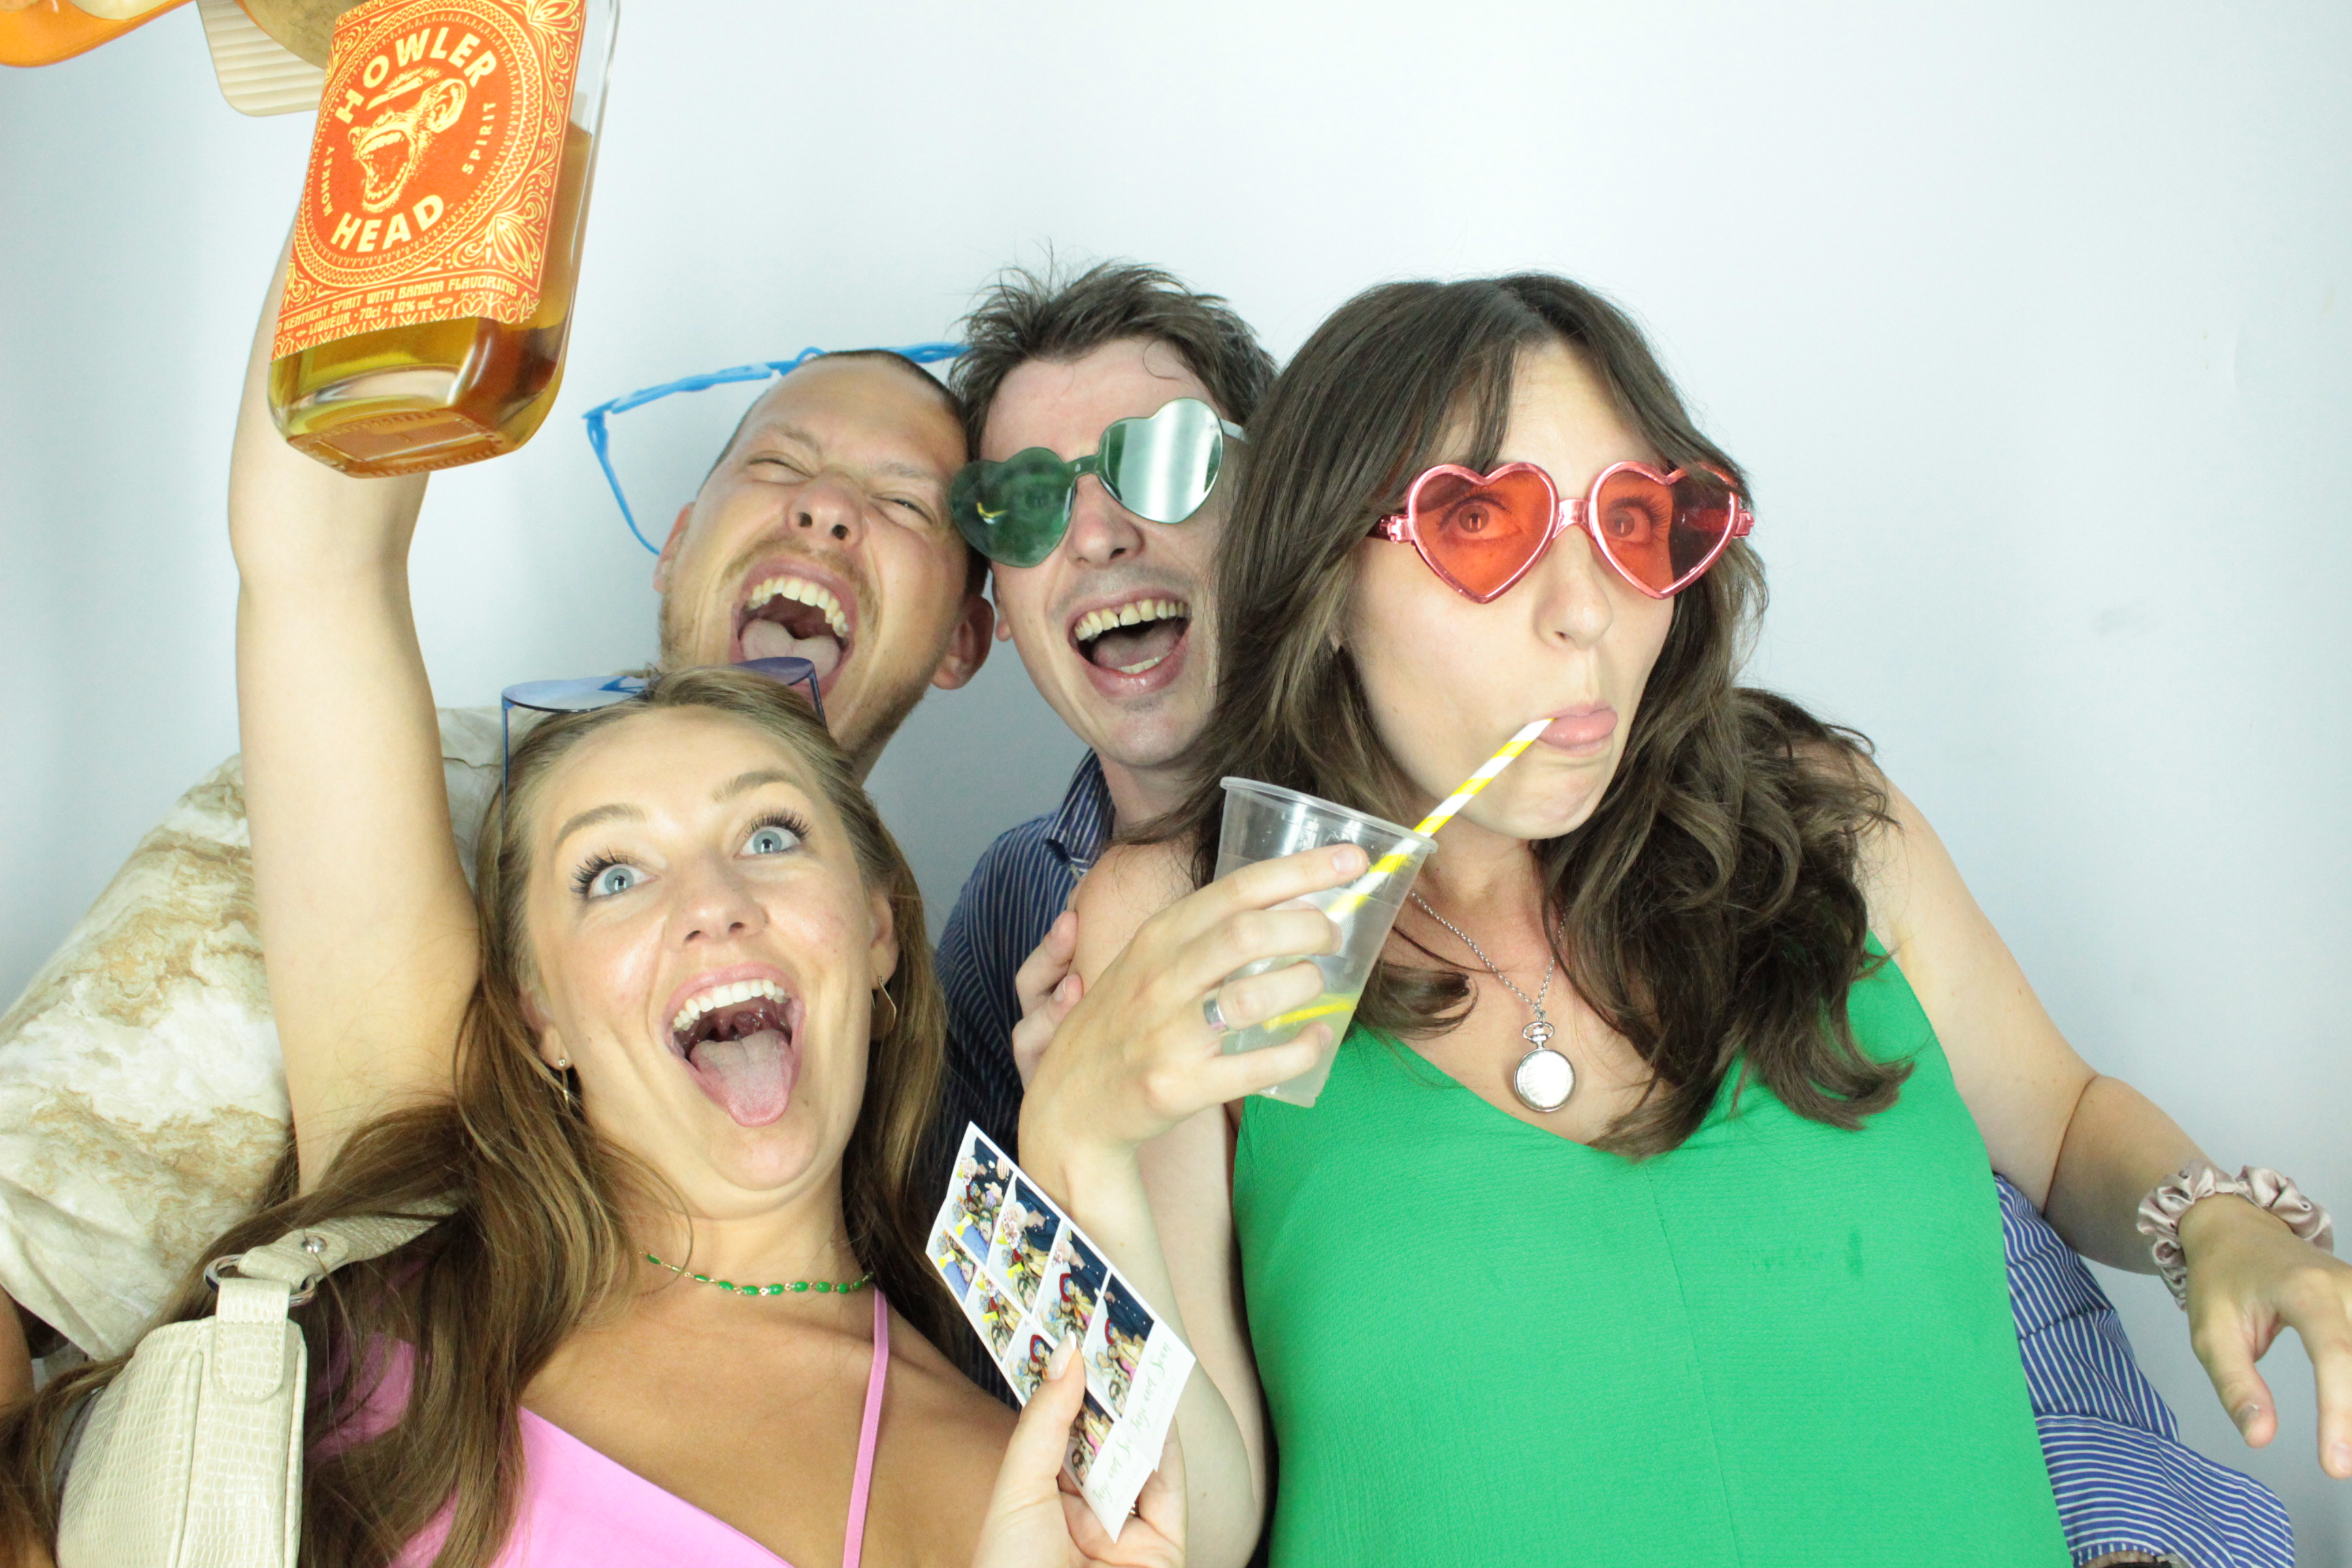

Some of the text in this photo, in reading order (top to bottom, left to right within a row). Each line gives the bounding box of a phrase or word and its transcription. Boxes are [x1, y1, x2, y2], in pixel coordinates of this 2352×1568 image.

[335, 27, 497, 124] HOWLER
[461, 103, 496, 175] SPIRIT
[321, 146, 336, 216] MONKEY
[330, 194, 444, 252] HEAD
[283, 304, 330, 331] KENTUCKY
[331, 294, 363, 314] SPIRIT
[367, 288, 395, 305] WITH
[397, 280, 444, 300] BANANA
[448, 274, 518, 297] FLAVORING
[308, 298, 436, 336] LIQUEUR 70cl 40% vol.
